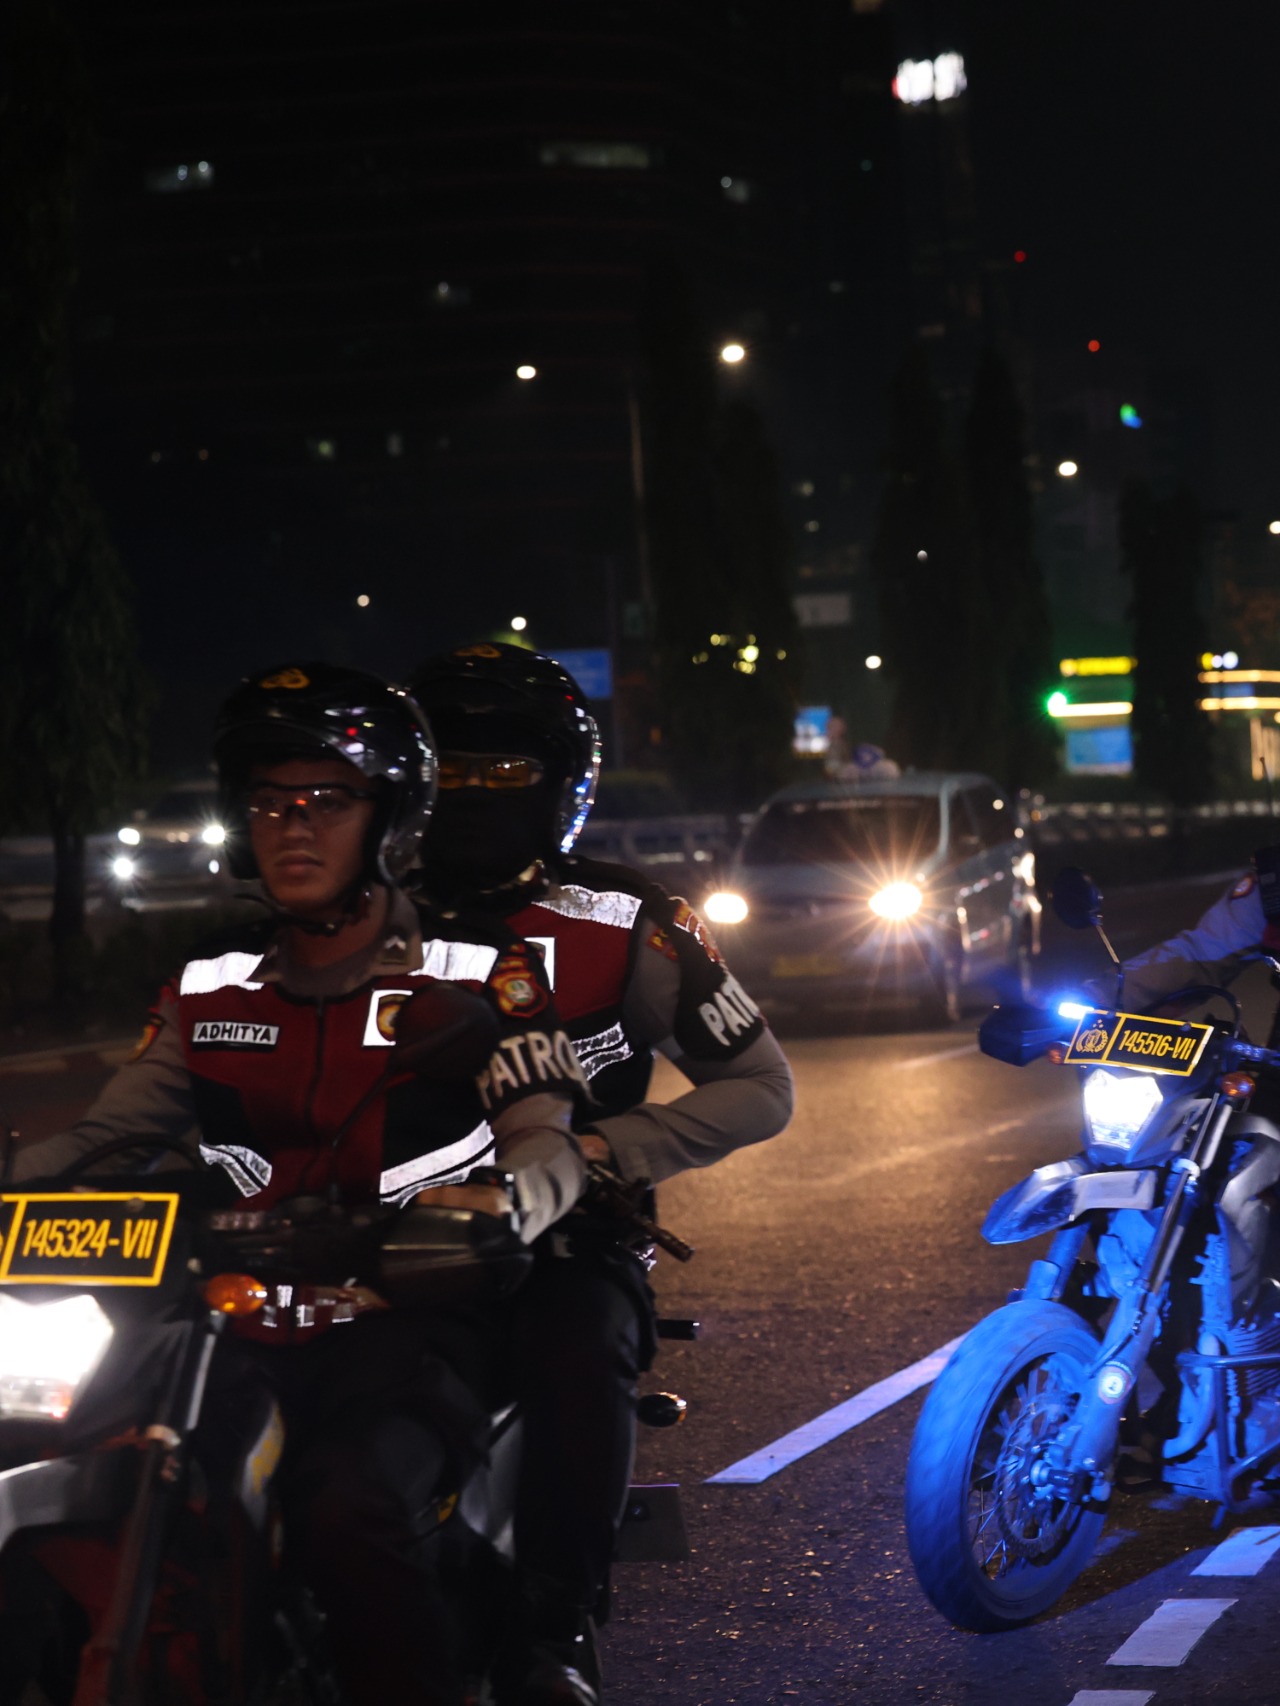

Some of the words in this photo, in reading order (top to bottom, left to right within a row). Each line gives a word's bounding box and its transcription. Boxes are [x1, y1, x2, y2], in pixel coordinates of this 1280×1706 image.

[197, 1024, 272, 1042] ADHITYA
[1118, 1029, 1197, 1060] 145516-VII
[22, 1218, 159, 1258] 145324-VII
